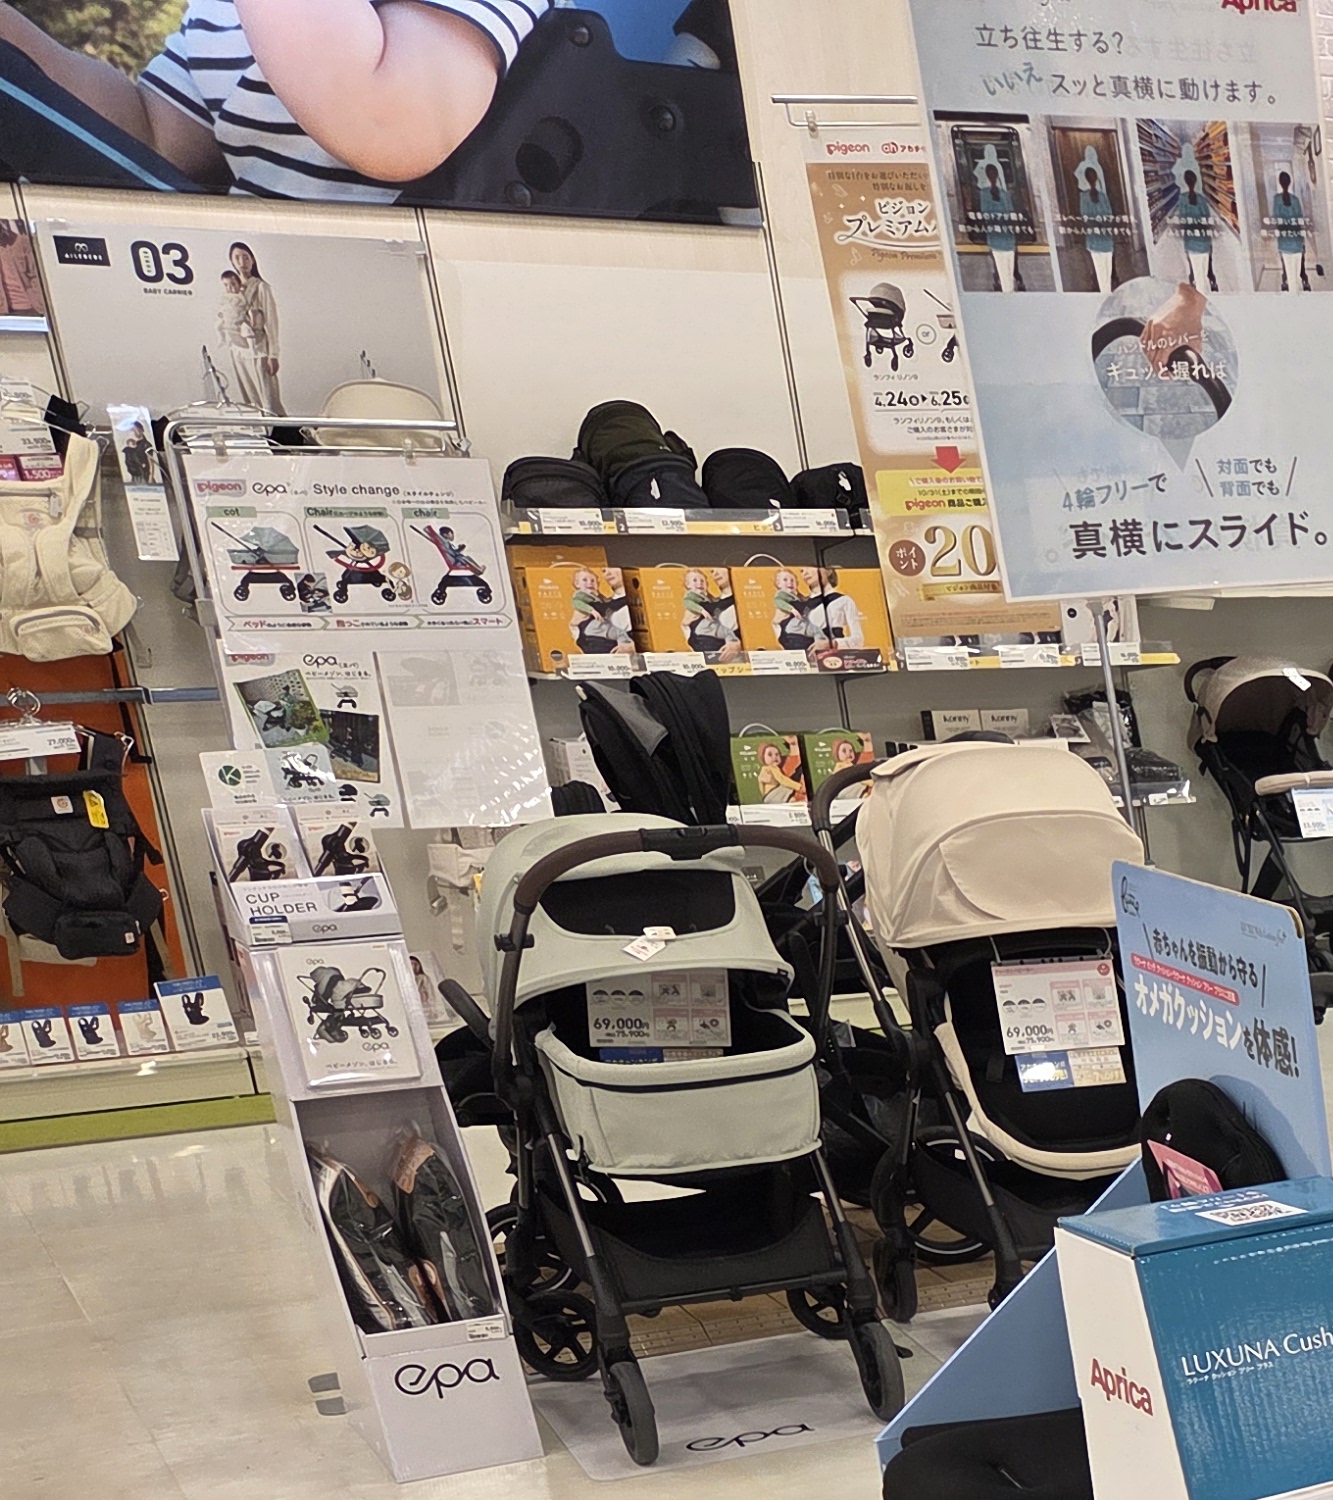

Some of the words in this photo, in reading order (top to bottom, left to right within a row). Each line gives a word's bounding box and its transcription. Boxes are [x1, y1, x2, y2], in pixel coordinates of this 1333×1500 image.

[975, 23, 1124, 55] 立ち往生する?
[1050, 75, 1277, 105] スッと真横に動けます。
[827, 143, 870, 155] pigeon
[878, 200, 929, 215] ピジョン
[130, 240, 194, 285] 03
[1217, 457, 1278, 475] 対面でも
[196, 481, 242, 494] pigeon
[252, 482, 288, 496] epa
[313, 483, 347, 496] Style
[352, 483, 400, 497] change
[1062, 472, 1167, 511] 4輪フリーで
[1219, 479, 1280, 497] 背面でも
[905, 498, 946, 511] pigeon
[1069, 510, 1328, 560] 真横にスライド。
[924, 524, 997, 577] 20
[303, 653, 338, 668] epa
[245, 892, 280, 905] CUP
[250, 902, 318, 916] HOLDER
[312, 923, 338, 934] epa
[1152, 927, 1259, 988] 赤ちゃんを振動から守る
[1134, 973, 1300, 1078] オメガクッションを体感!
[362, 1042, 390, 1053] epa
[1181, 1339, 1281, 1378] LUXUNA
[395, 1358, 501, 1400] epa
[1090, 1357, 1154, 1417] Aprica
[685, 1421, 815, 1455] epa
